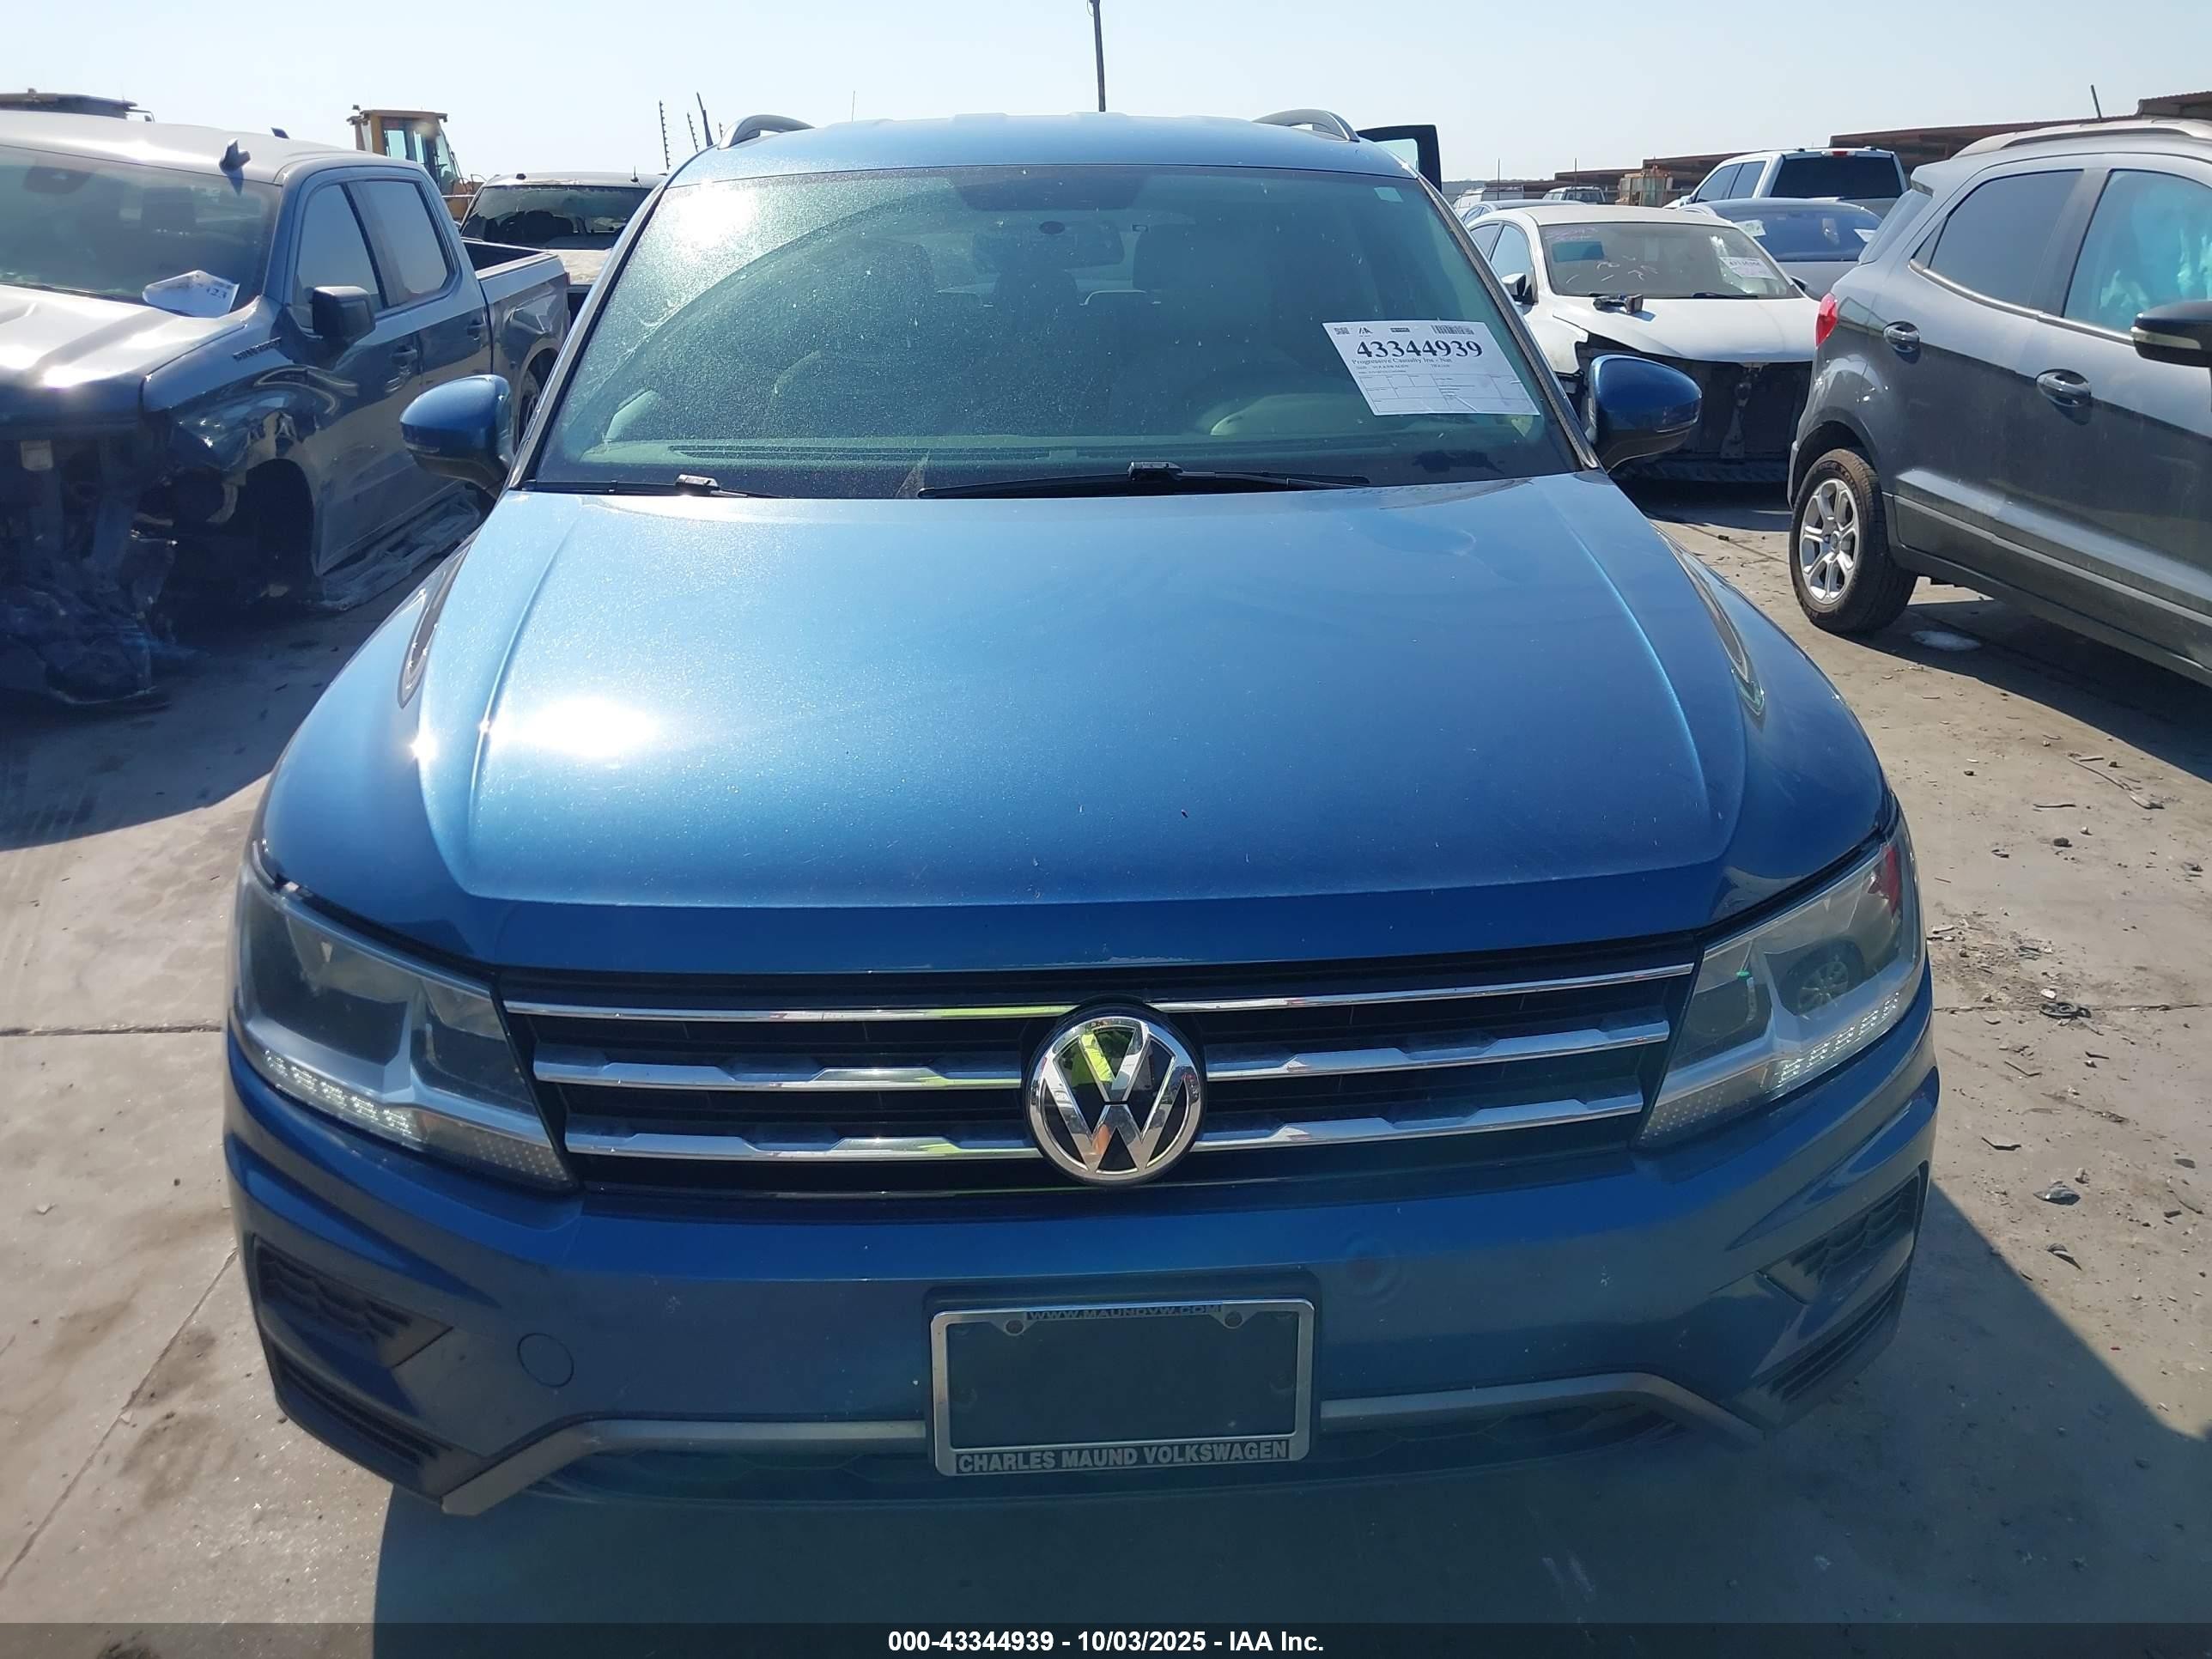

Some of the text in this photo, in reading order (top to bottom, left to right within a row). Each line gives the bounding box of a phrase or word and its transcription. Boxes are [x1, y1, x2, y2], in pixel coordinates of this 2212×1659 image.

[1357, 340, 1483, 357] 43344939
[1030, 1304, 1220, 1321] WWW.MAUNDVW.COM
[957, 1441, 1287, 1474] CHARLES MAUND VOLKSWAGEN
